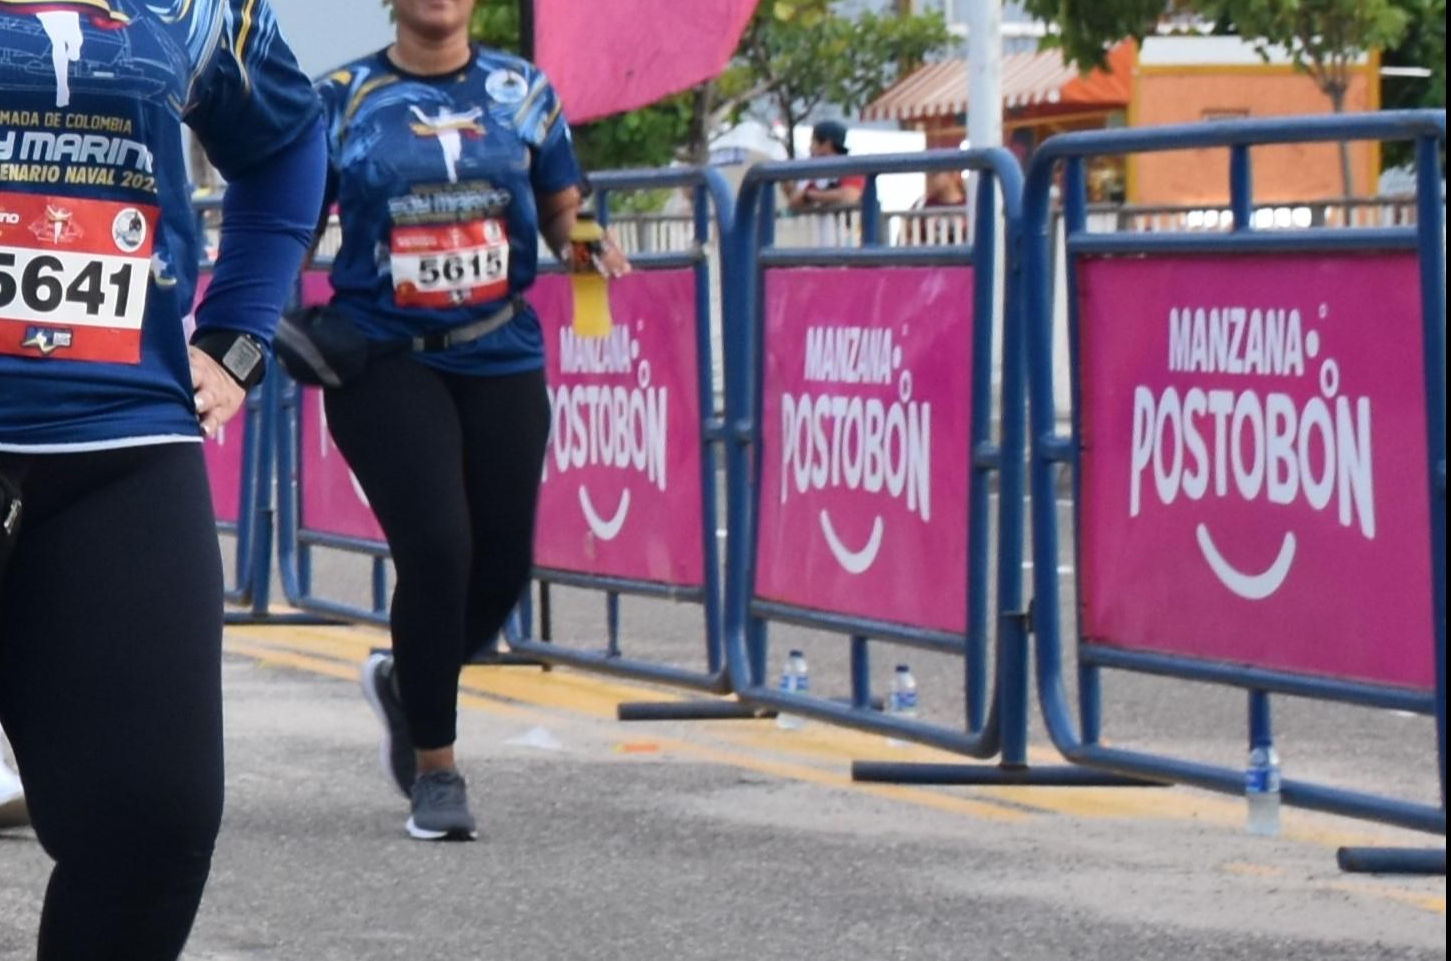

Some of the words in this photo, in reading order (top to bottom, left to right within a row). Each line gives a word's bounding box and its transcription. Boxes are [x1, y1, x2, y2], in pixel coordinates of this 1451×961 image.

[44, 112, 63, 129] DE
[65, 113, 133, 135] COLOMBIA
[19, 131, 154, 174] MARIN
[64, 165, 116, 186] NAVAL
[418, 250, 502, 283] 5615
[804, 326, 894, 385] MANZANA
[1168, 306, 1305, 378] MANZANA
